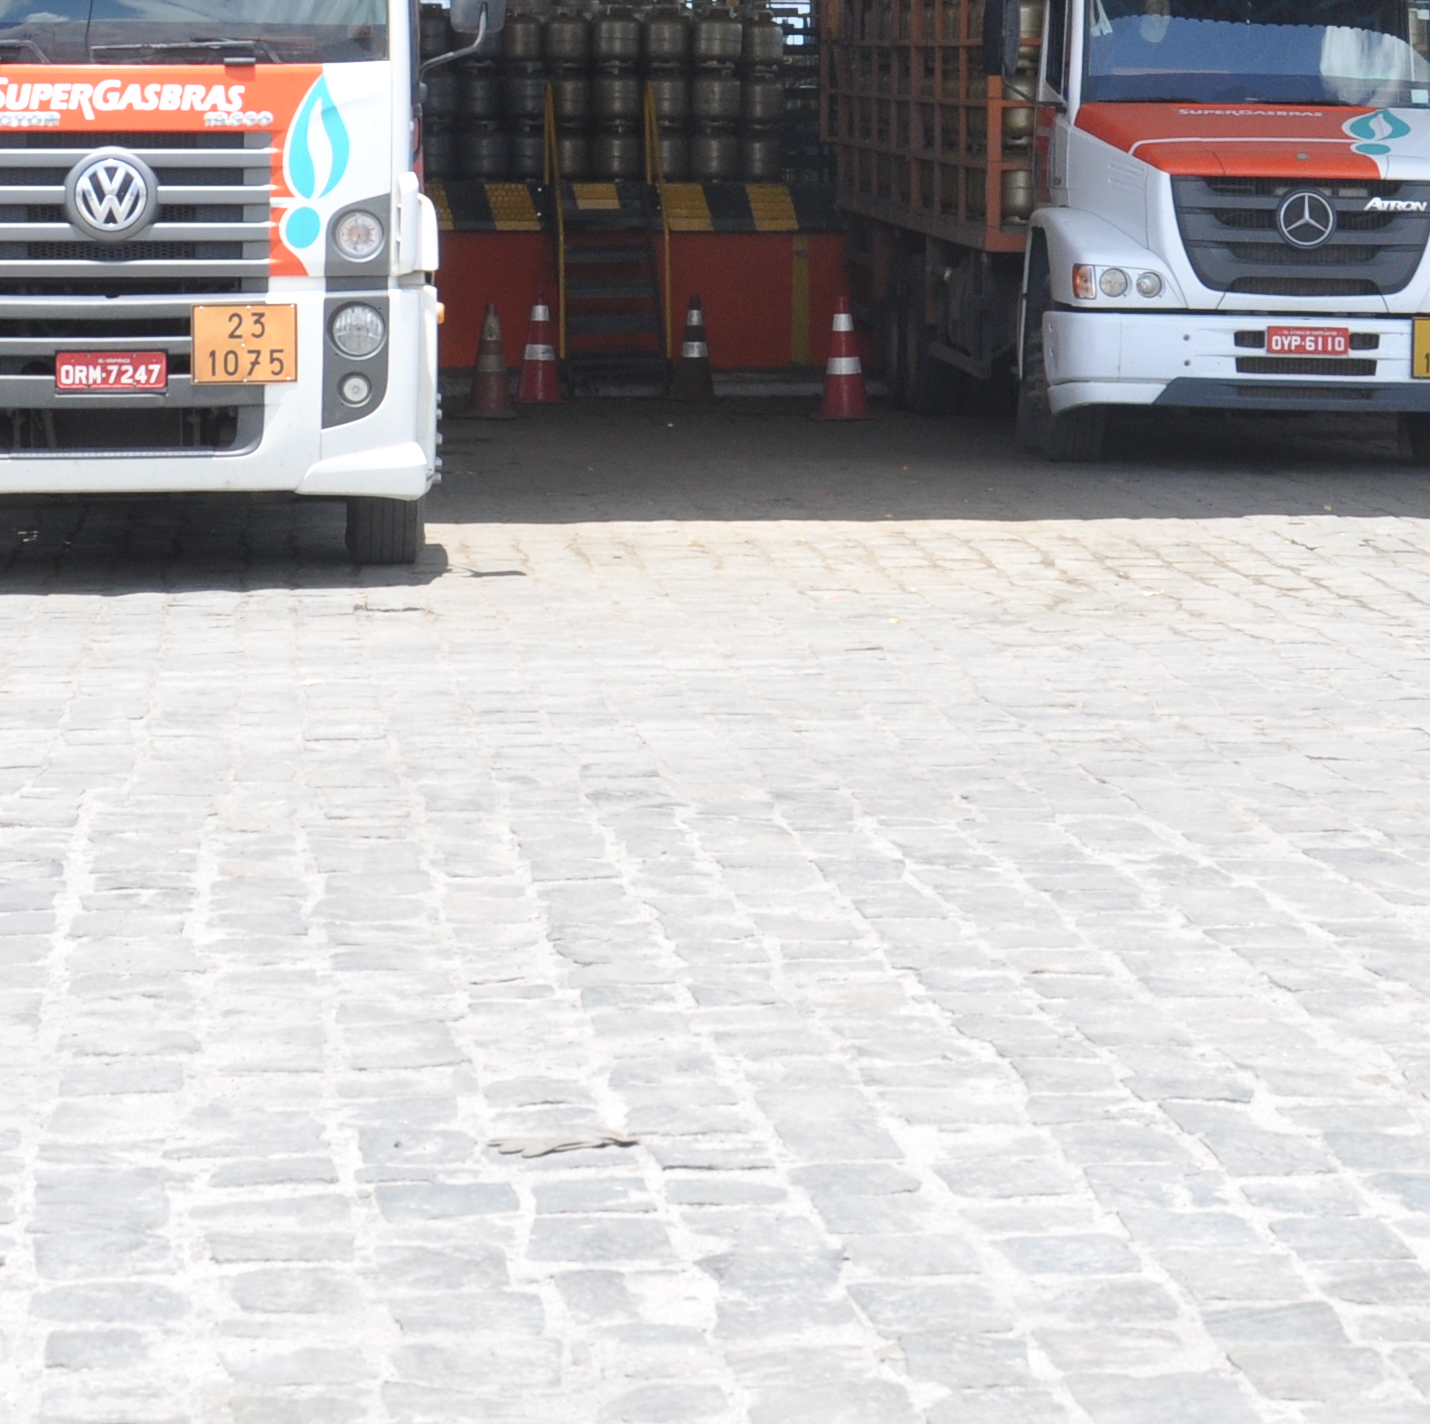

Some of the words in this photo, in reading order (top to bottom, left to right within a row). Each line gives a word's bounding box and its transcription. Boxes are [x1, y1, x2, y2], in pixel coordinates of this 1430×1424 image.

[1363, 196, 1428, 212] ATRON
[227, 312, 266, 339] 23
[208, 348, 285, 377] 1075
